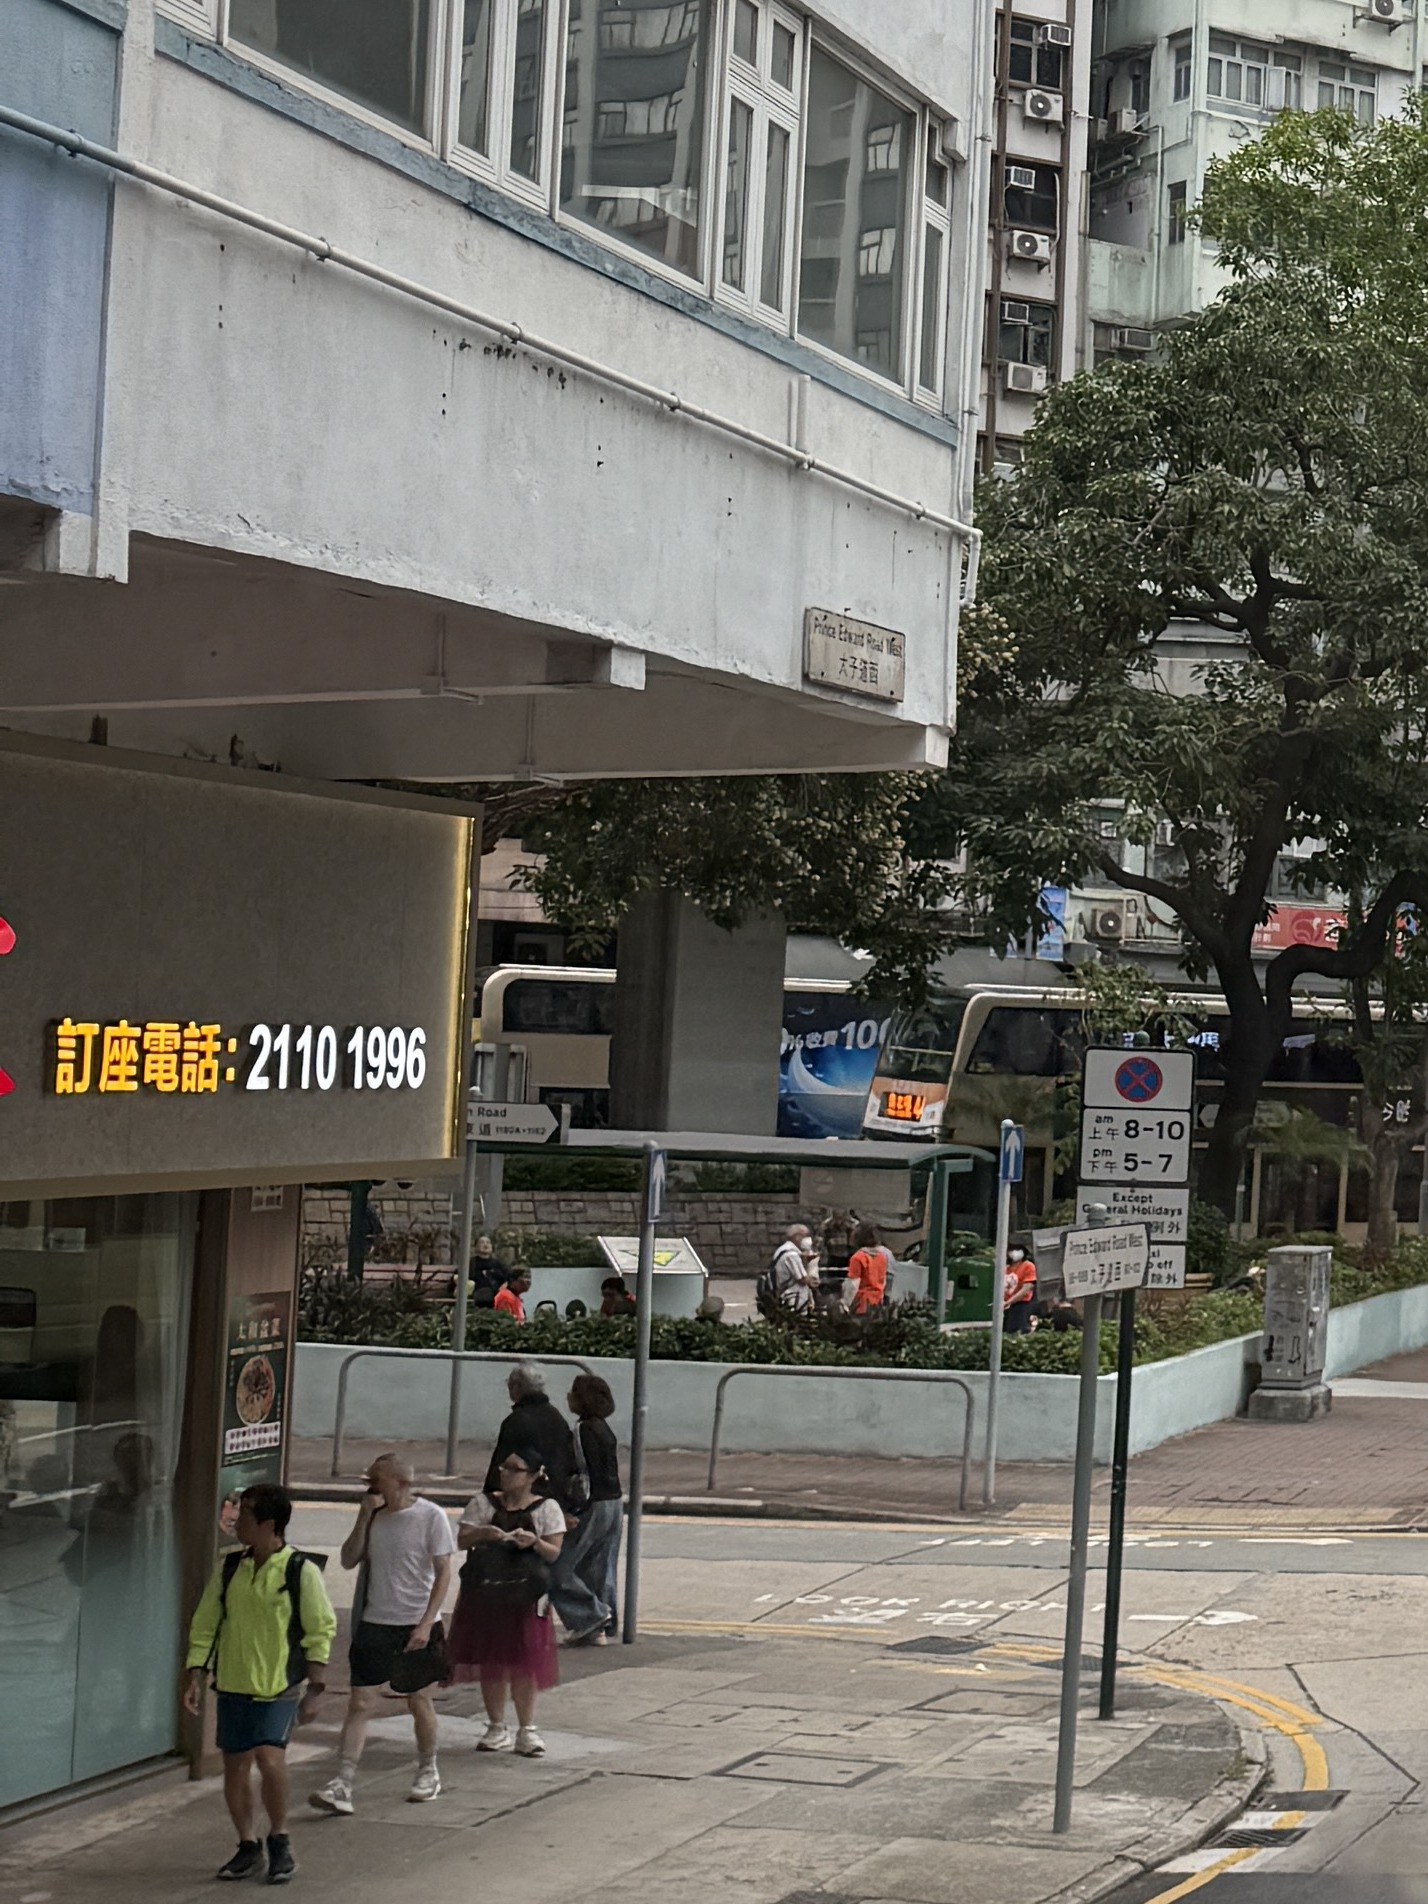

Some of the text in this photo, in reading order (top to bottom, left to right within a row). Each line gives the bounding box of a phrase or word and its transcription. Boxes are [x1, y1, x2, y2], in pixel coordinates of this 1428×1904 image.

[245, 1023, 337, 1091] 2110
[347, 1023, 427, 1091] 1996
[477, 1106, 507, 1118] Road
[1095, 1114, 1114, 1124] am
[1088, 1127, 1119, 1141] 上午
[1124, 1119, 1184, 1140] 8-10
[1093, 1148, 1112, 1159] pm
[1088, 1161, 1117, 1173] 下午
[1113, 1193, 1153, 1204] Except
[1082, 1203, 1182, 1217] Geral Holidays
